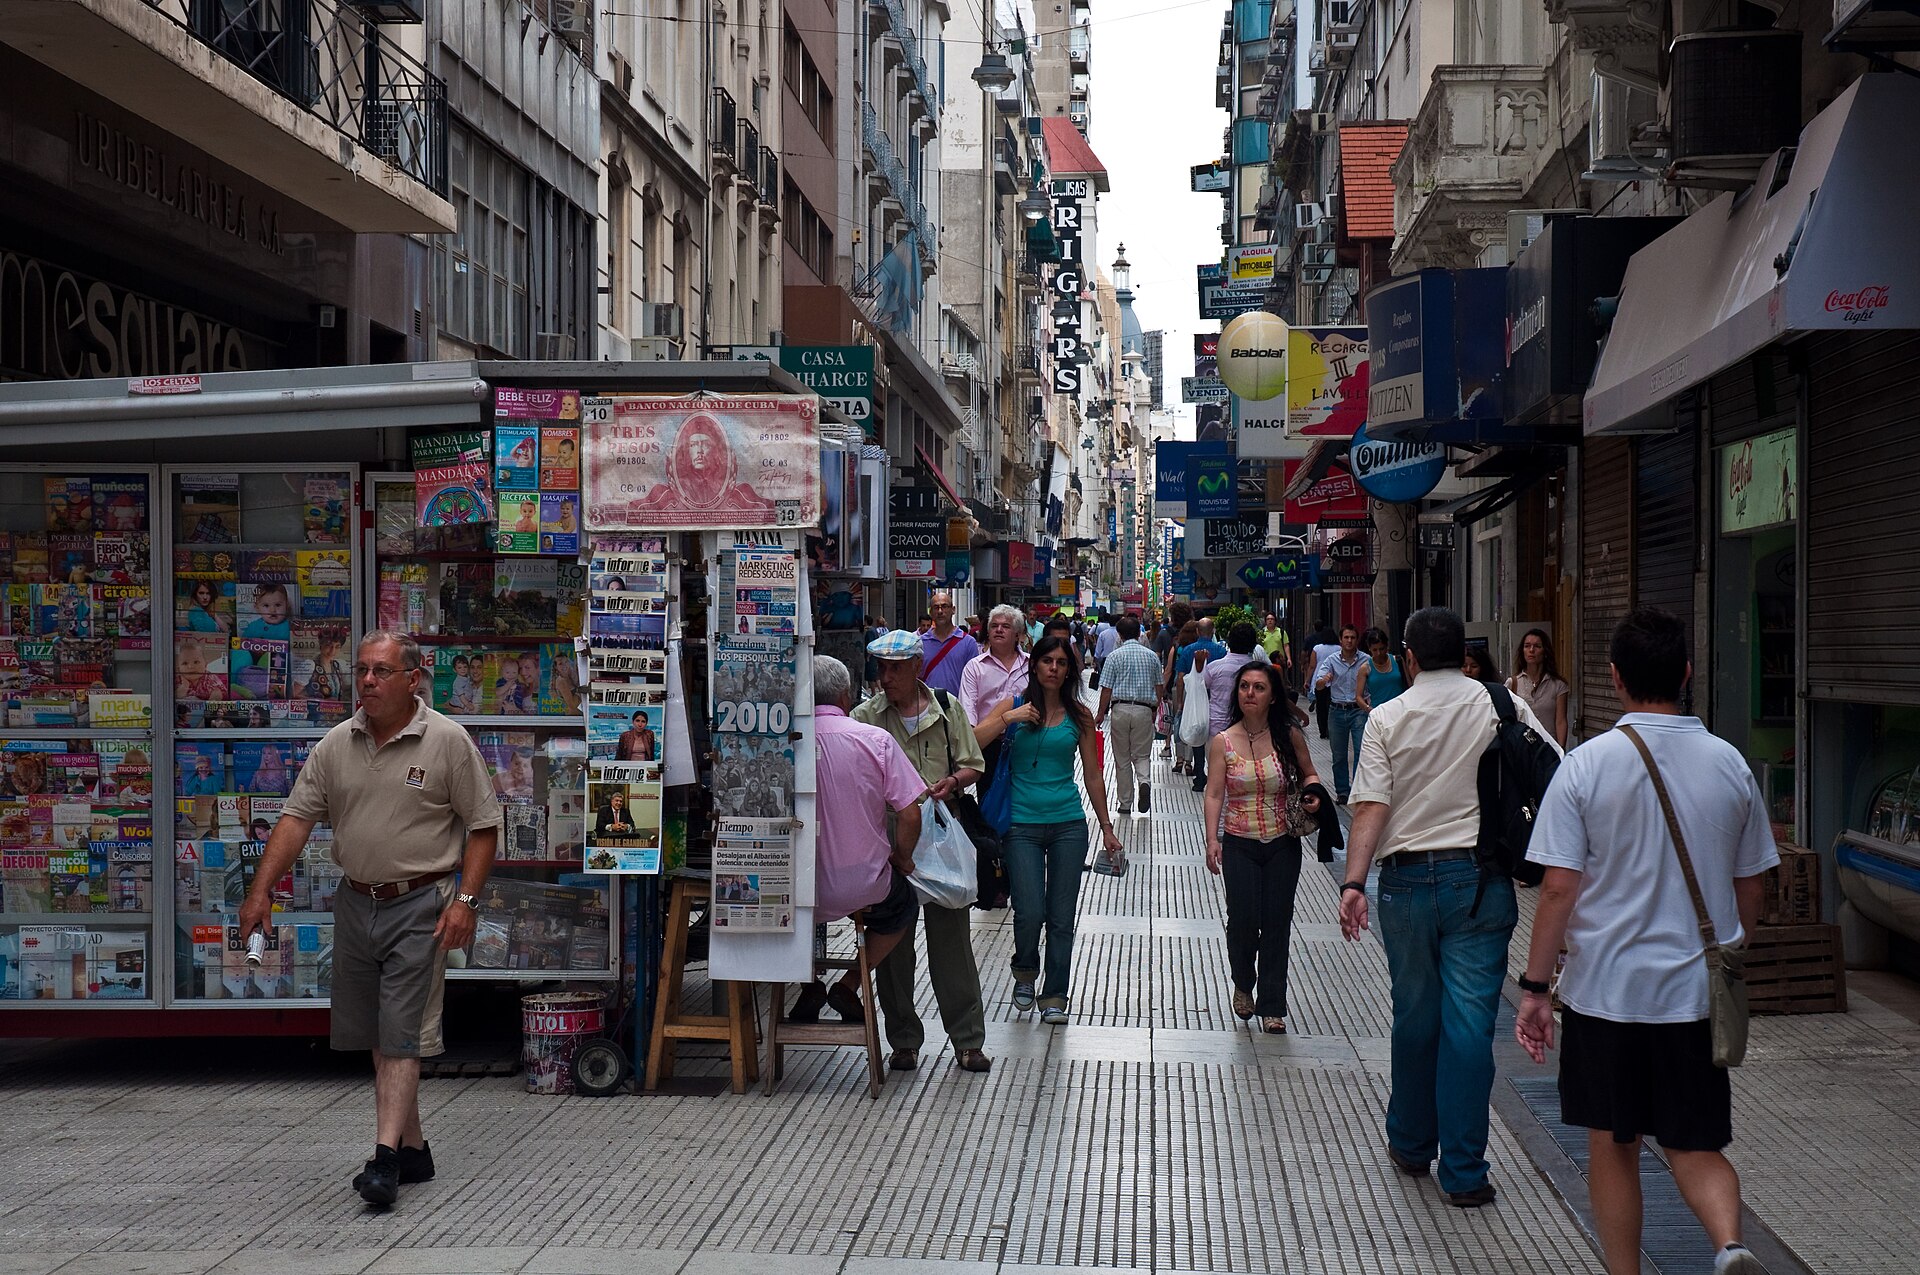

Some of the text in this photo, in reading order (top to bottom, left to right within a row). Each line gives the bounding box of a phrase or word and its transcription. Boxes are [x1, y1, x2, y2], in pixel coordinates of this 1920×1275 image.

[76, 112, 249, 243] URIBELARREA
[1051, 181, 1086, 196] CISAS
[1242, 248, 1272, 256] ALQUILA
[1825, 286, 1889, 312] Coca-Cola
[1845, 310, 1874, 324] light
[1311, 343, 1369, 354] RECARG
[802, 352, 846, 366] CASA
[163, 376, 196, 386] CELTAS
[789, 372, 868, 387] IHARCE
[499, 392, 552, 403] BEBÉ FELIZ
[1188, 389, 1227, 397] VENDE
[629, 402, 665, 410] BANCO
[668, 401, 728, 410] NACIONAL
[744, 401, 776, 410] CUBA
[1373, 384, 1413, 418] CITIZEN
[612, 427, 656, 438] TRES
[414, 433, 481, 450] MANDALAS
[608, 442, 660, 454] PESOS
[414, 450, 434, 458] PARA
[617, 457, 646, 465] 691802
[418, 465, 486, 482] MANDALAS
[1160, 471, 1185, 485] Wall
[92, 482, 146, 493] muñecos
[890, 522, 940, 532] LEATHER FACTORY
[1322, 520, 1370, 528] RESTAURANT
[890, 535, 940, 546] CRAYON
[96, 543, 128, 554] FIBRO
[496, 566, 556, 574] GARDENS
[607, 557, 650, 573] informe
[739, 562, 794, 570] MARKETING
[739, 570, 794, 580] REDES SOCIALES
[607, 596, 649, 612] informe
[241, 640, 286, 654] Crochet
[293, 641, 316, 650] 2010
[606, 654, 648, 670] informe
[717, 652, 780, 662] LOS PERSONAJES
[604, 688, 647, 705] informe
[101, 700, 142, 712] maru
[95, 712, 150, 728] botana
[717, 700, 790, 734] 2010
[72, 758, 88, 767] gusto
[117, 766, 138, 774] mucho
[604, 766, 644, 782] informe
[252, 800, 284, 810] Estética
[718, 820, 754, 836] Tiempo
[716, 852, 746, 861] Desalojan
[22, 926, 52, 934] PROYECTO
[88, 934, 102, 944] AD
